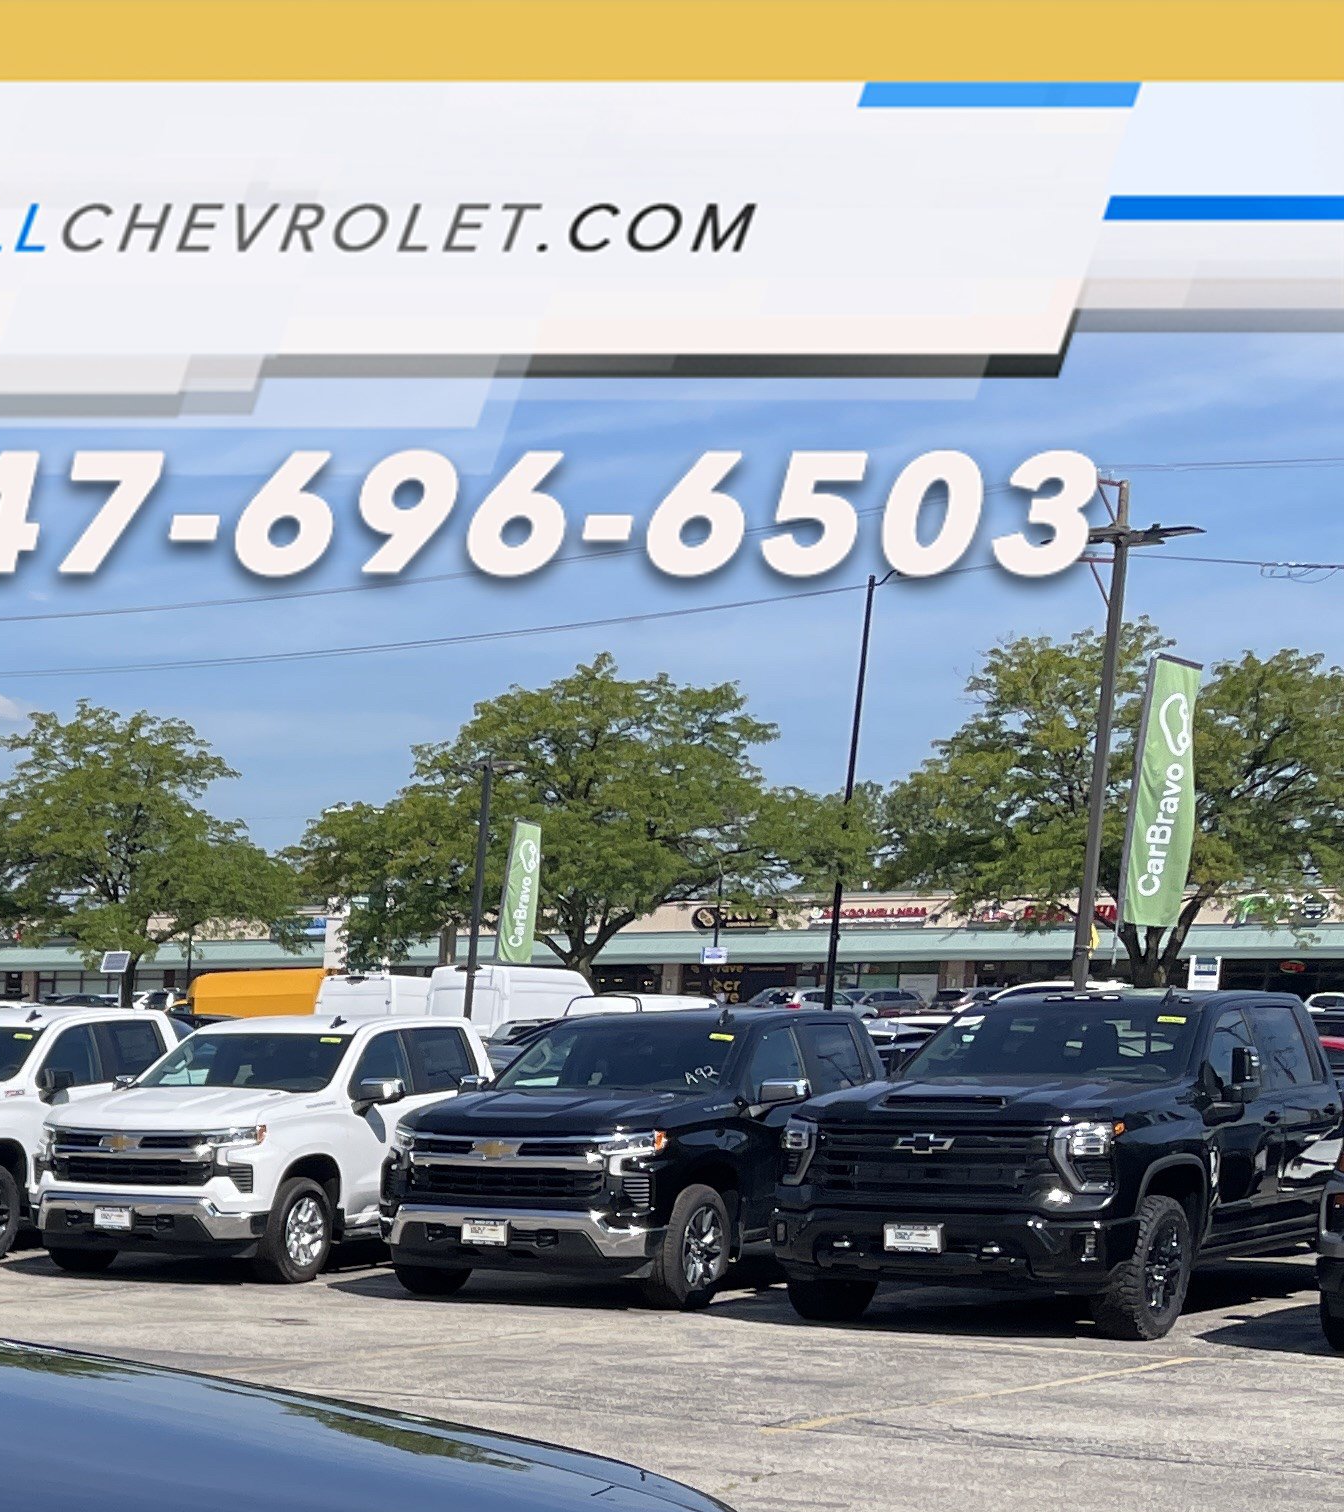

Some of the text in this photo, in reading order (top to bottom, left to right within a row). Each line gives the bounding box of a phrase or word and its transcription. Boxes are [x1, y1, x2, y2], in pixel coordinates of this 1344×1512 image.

[1138, 763, 1184, 896] CarBravo
[508, 876, 532, 947] CarBravo
[685, 1065, 719, 1085] A92
